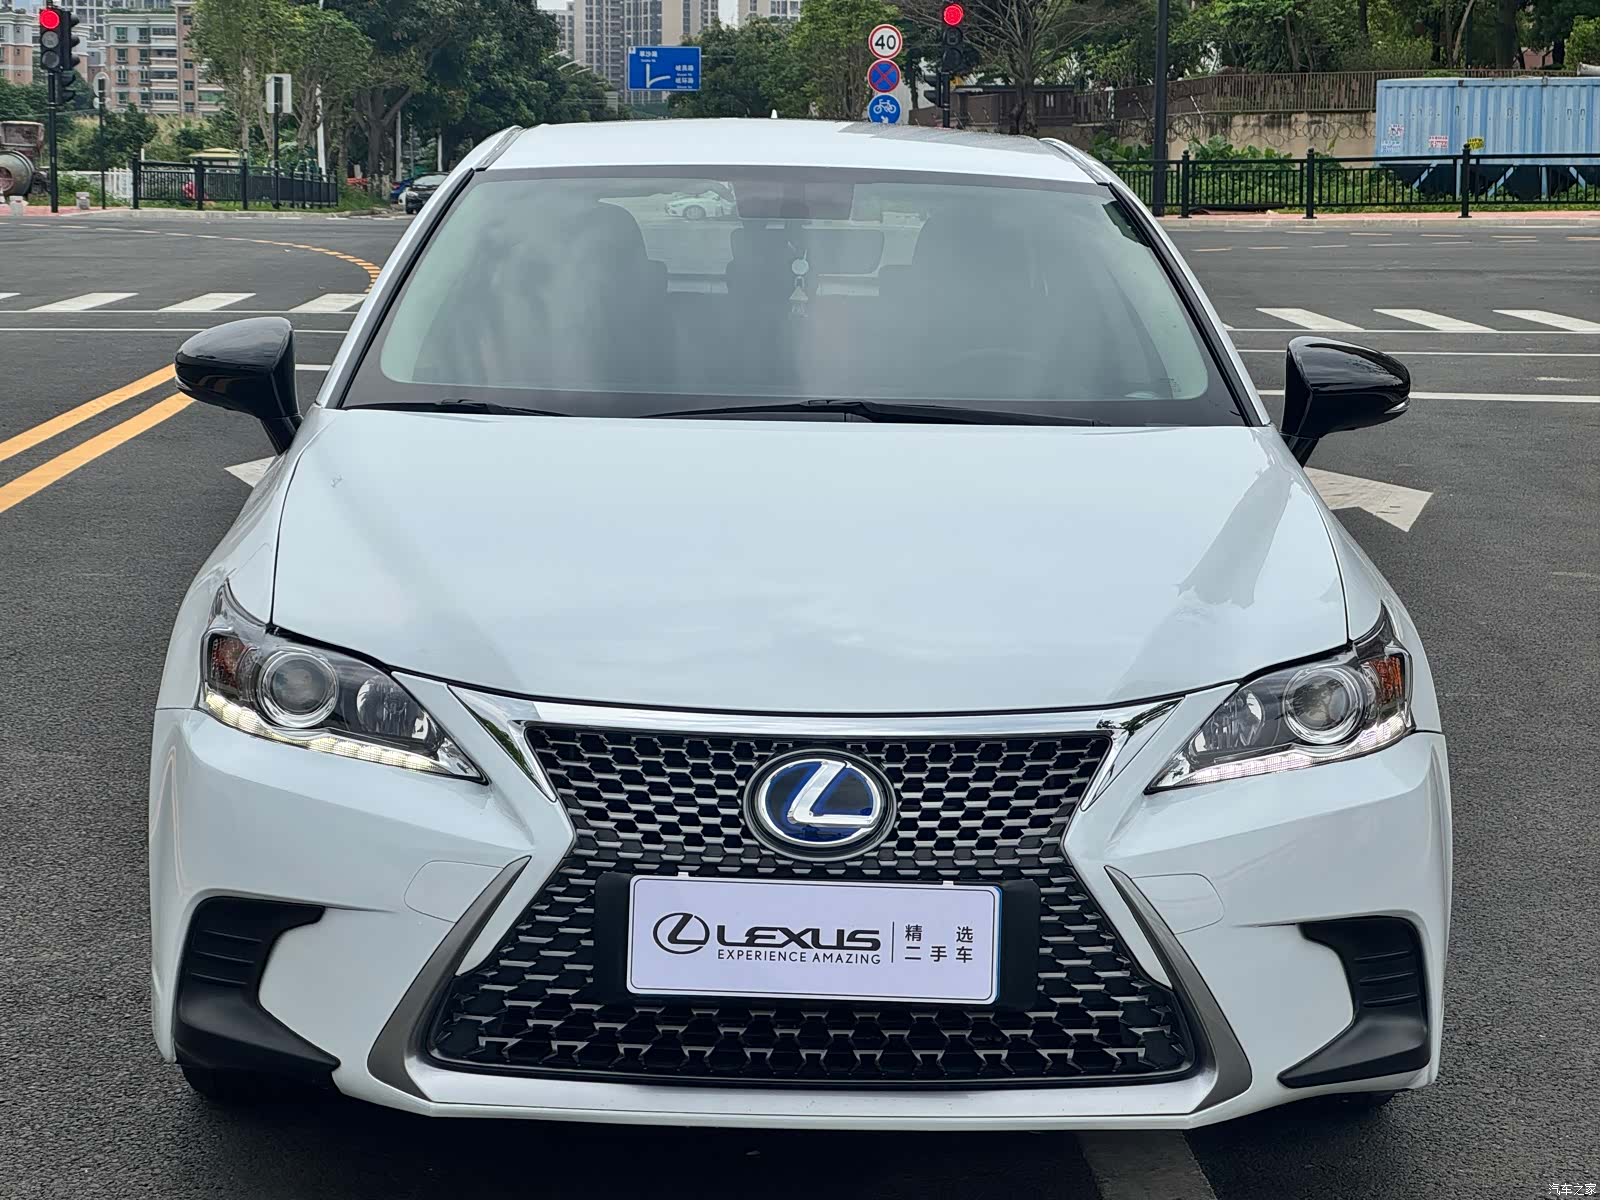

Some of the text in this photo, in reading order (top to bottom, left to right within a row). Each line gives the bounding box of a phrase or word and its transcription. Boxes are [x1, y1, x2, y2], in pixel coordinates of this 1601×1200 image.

[875, 35, 896, 50] 40
[716, 924, 882, 952] LEXUS
[717, 949, 882, 965] EXPERIENCE AMAZING
[904, 945, 974, 964] 二手车
